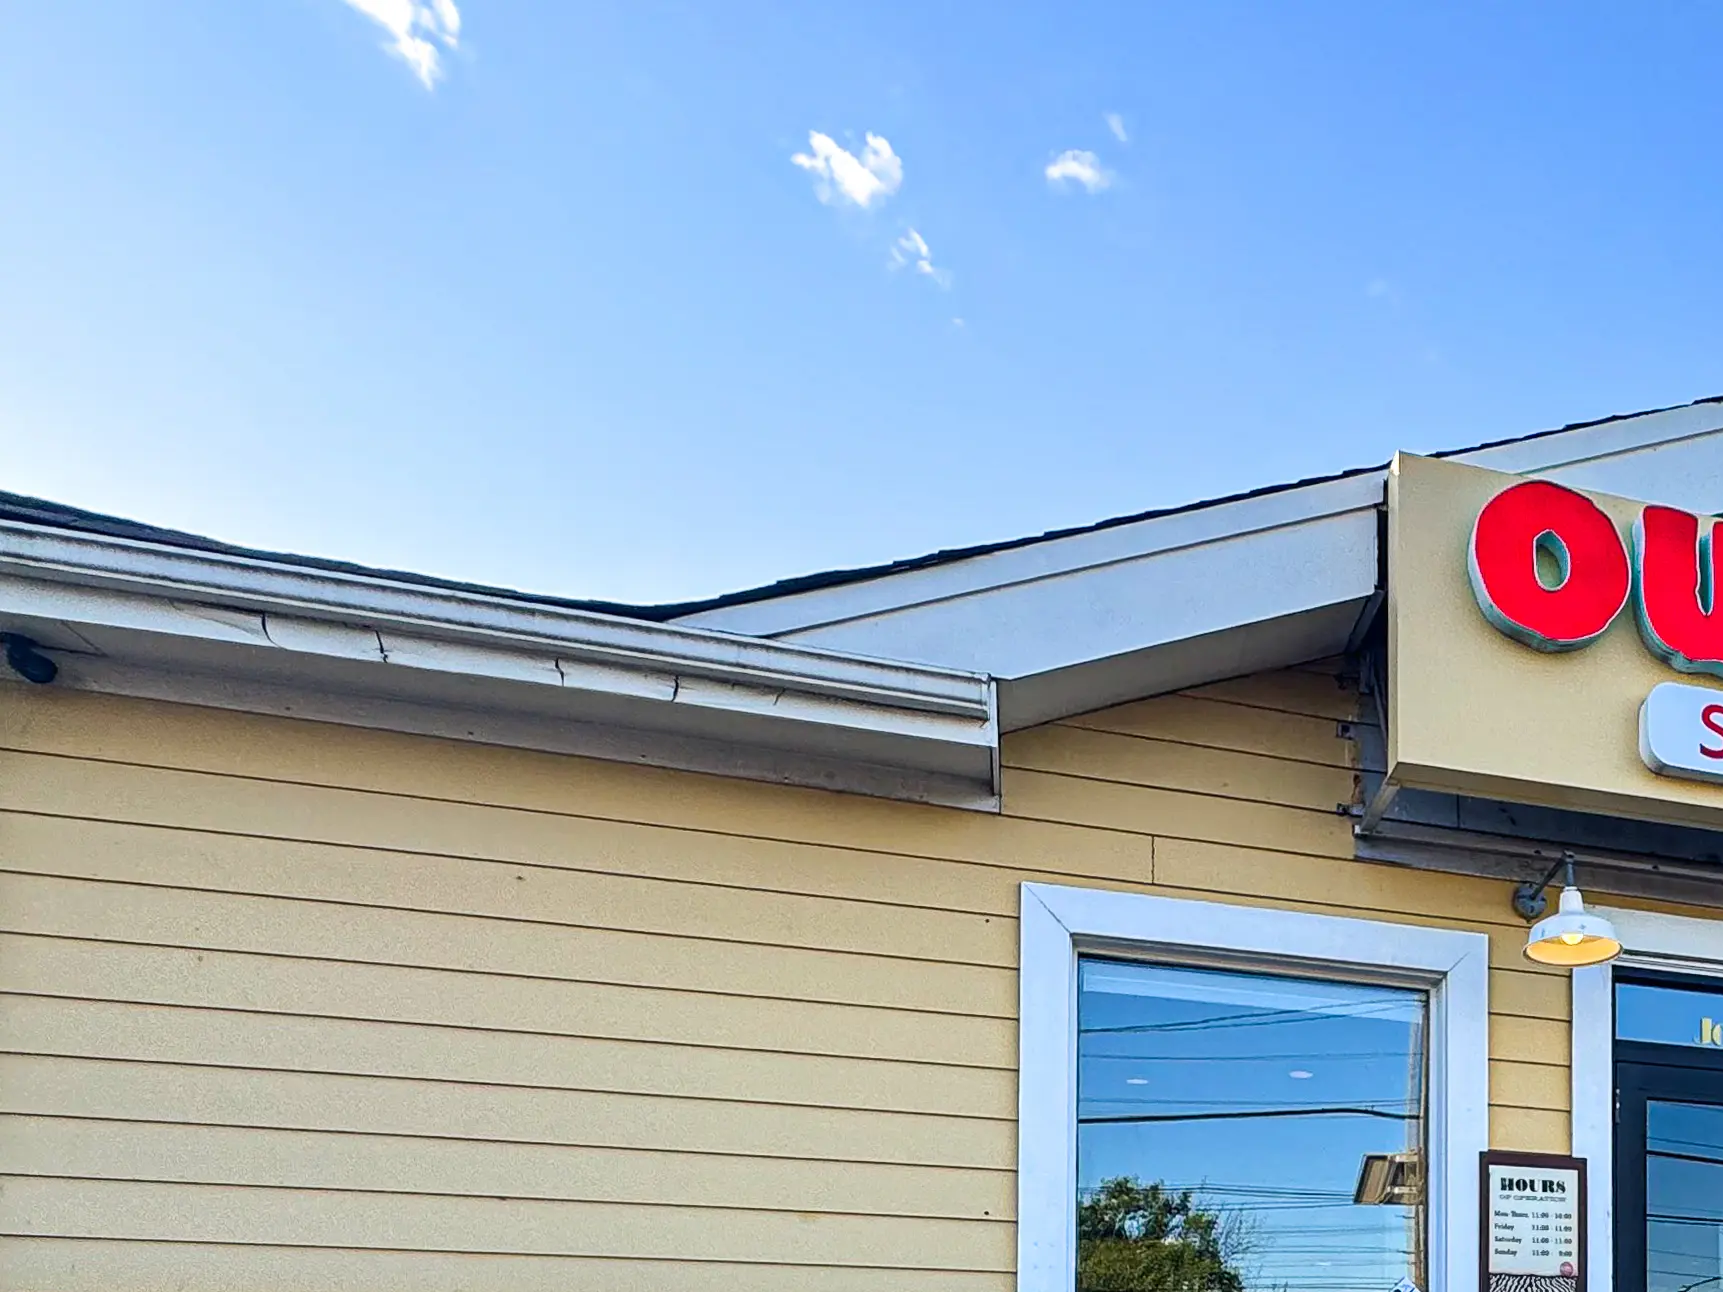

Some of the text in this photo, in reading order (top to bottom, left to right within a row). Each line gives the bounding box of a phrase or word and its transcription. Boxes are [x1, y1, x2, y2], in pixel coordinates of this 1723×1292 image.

[1500, 1177, 1566, 1193] HOURS
[1494, 1223, 1515, 1231] Friday
[1494, 1236, 1523, 1244] Saturday
[1494, 1248, 1518, 1257] Sunday
